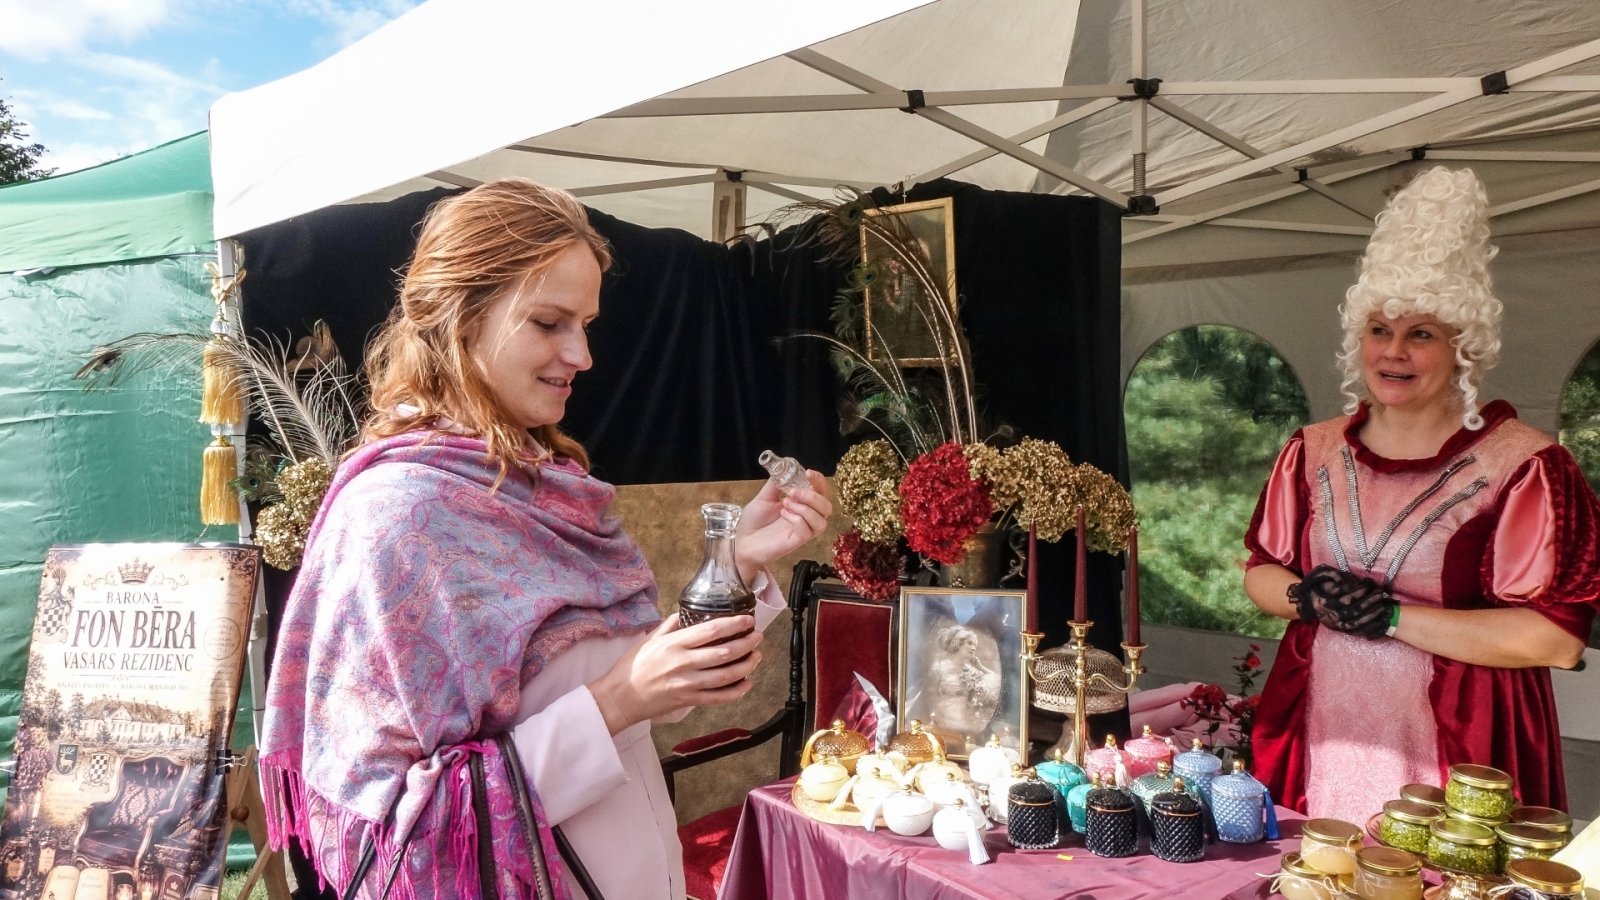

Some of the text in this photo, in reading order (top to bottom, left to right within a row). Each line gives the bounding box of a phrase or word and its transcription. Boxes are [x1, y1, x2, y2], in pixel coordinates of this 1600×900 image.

[106, 591, 160, 604] BARONA
[71, 605, 196, 649] FON BĒRA
[63, 652, 116, 670] VASARS
